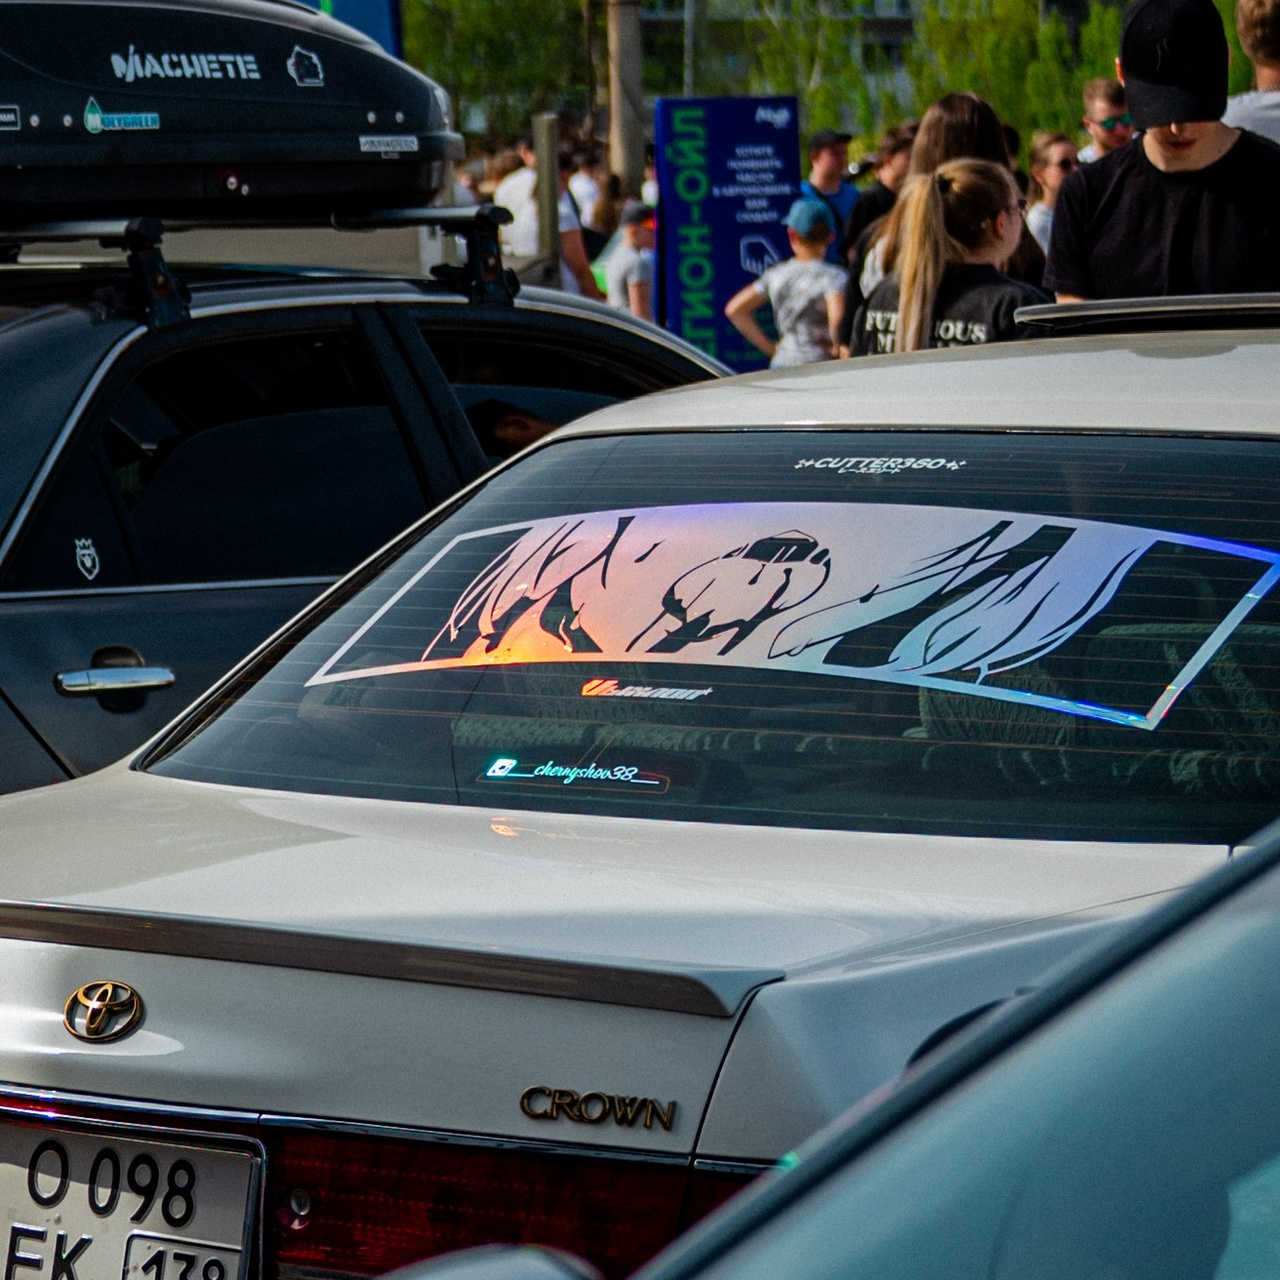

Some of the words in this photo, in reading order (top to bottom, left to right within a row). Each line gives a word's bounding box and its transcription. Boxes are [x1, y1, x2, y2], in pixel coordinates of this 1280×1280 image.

[110, 44, 261, 82] MACHETE
[814, 457, 946, 469] CUTTER360
[519, 1085, 677, 1131] CROWN
[88, 1147, 197, 1229] 098
